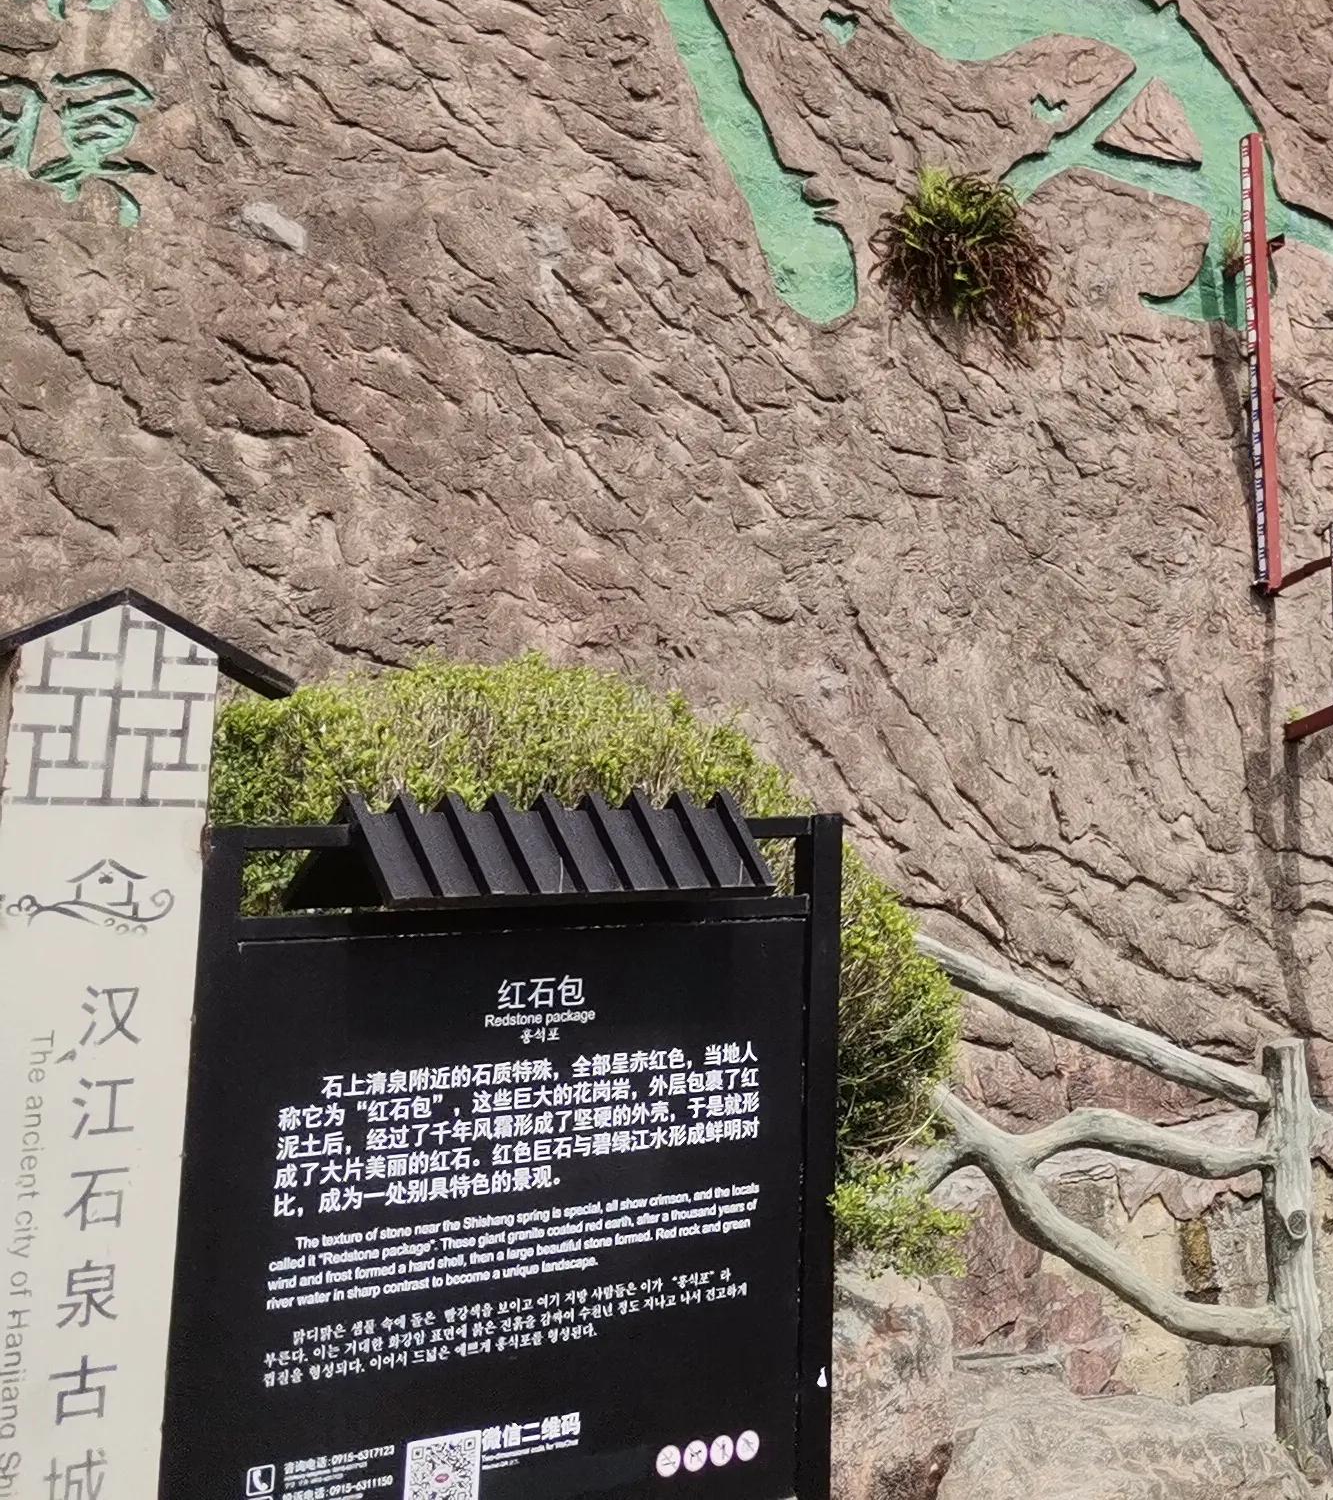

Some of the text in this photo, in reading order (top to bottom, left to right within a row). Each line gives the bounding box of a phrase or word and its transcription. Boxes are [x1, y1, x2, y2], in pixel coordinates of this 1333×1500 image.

[484, 1009, 596, 1028] Redstone package
[497, 975, 586, 1010] 红石包
[29, 1028, 55, 1083] The
[17, 1095, 46, 1200] ancient
[6, 1210, 38, 1259] city
[43, 984, 143, 1500] 汉江石泉古城
[269, 1255, 305, 1272] called
[308, 1254, 316, 1267] it
[441, 1237, 474, 1251] These
[478, 1231, 505, 1248] giant
[507, 1227, 544, 1244] granite
[547, 1220, 582, 1236] coated
[585, 1218, 602, 1232] red
[637, 1213, 660, 1225] after
[662, 1213, 669, 1222] a
[671, 1204, 716, 1221] thousand
[719, 1203, 744, 1218] years
[747, 1199, 757, 1211] of
[296, 1236, 318, 1250] The
[322, 1232, 362, 1247] texture
[366, 1227, 377, 1241] of
[380, 1227, 411, 1239] stone
[415, 1223, 441, 1235] near
[443, 1220, 460, 1232] the
[517, 1209, 549, 1224] spring
[552, 1207, 561, 1218] is
[606, 1199, 618, 1212] all
[620, 1198, 648, 1210] show
[693, 1188, 712, 1201] and
[715, 1187, 730, 1198] the
[732, 1182, 759, 1196] locals
[268, 1275, 296, 1291] wind
[299, 1272, 322, 1286] and
[326, 1269, 352, 1283] frost
[355, 1262, 395, 1279] formed
[398, 1264, 404, 1274] a
[408, 1257, 434, 1273] hard
[496, 1251, 504, 1261] a
[507, 1247, 533, 1260] large
[536, 1238, 581, 1256] beautiful
[584, 1237, 612, 1249] stone
[656, 1227, 676, 1241] Red
[679, 1223, 700, 1237] rock
[702, 1221, 720, 1234] and
[723, 1219, 750, 1233] green
[8, 1270, 33, 1302] of
[267, 1297, 294, 1310] river
[297, 1292, 330, 1306] water
[333, 1289, 344, 1301] in
[347, 1286, 380, 1299] sharp
[383, 1277, 429, 1294] contrast
[432, 1276, 443, 1288] to
[446, 1271, 490, 1286] become
[493, 1270, 500, 1279] a
[503, 1264, 538, 1278] unique
[481, 1411, 581, 1453] 微信二维码
